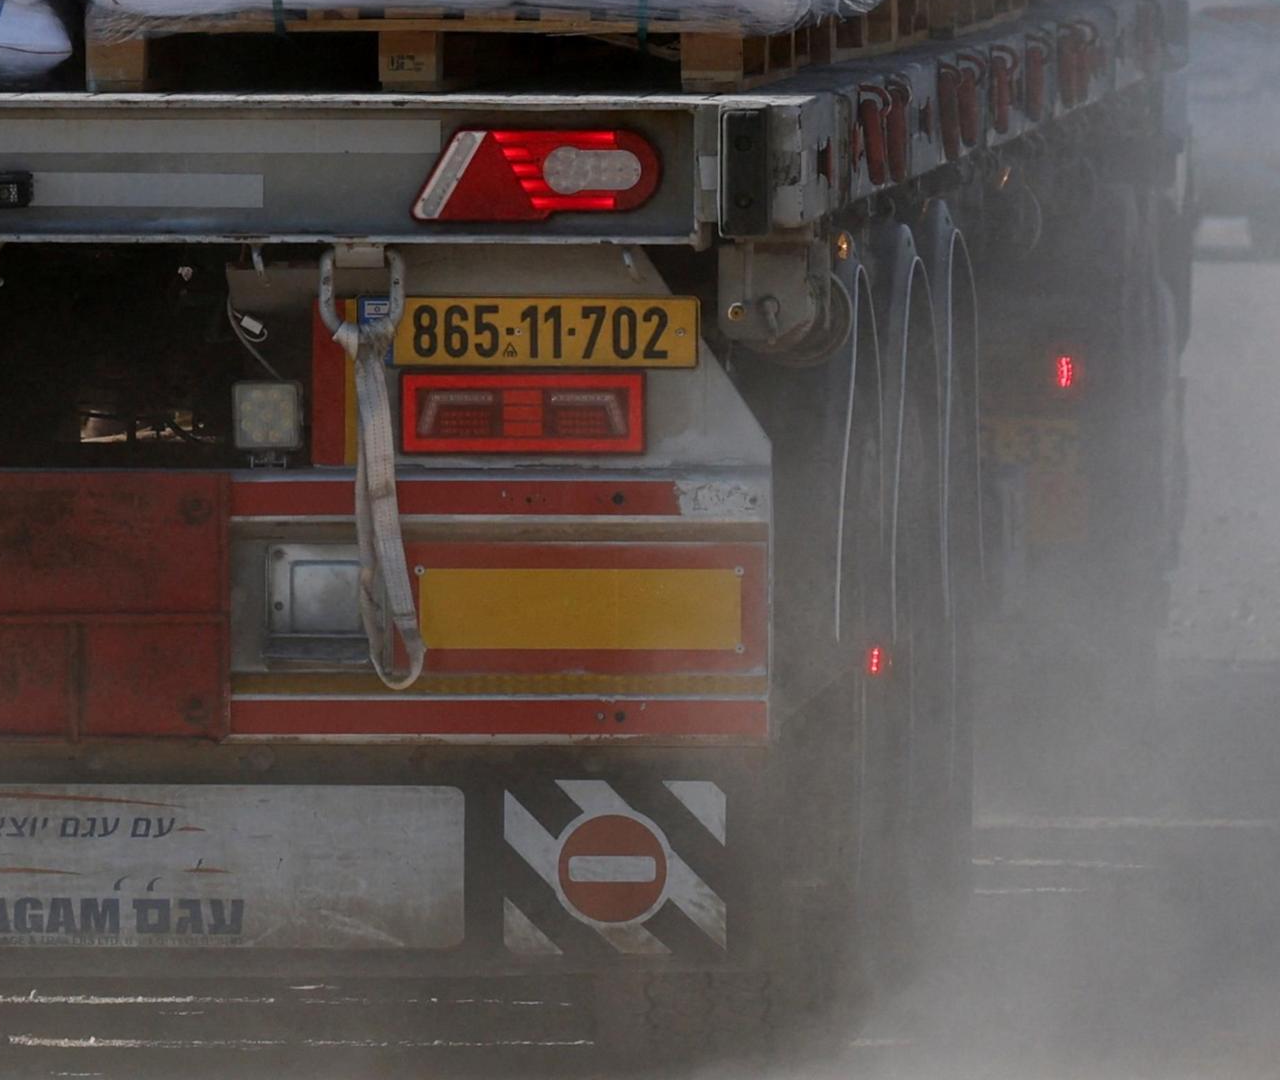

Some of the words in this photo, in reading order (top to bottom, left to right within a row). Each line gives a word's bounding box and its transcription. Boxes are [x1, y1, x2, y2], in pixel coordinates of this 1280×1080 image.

[59, 814, 119, 839] עגם
[130, 816, 176, 838] עם
[132, 898, 245, 935] עגם
